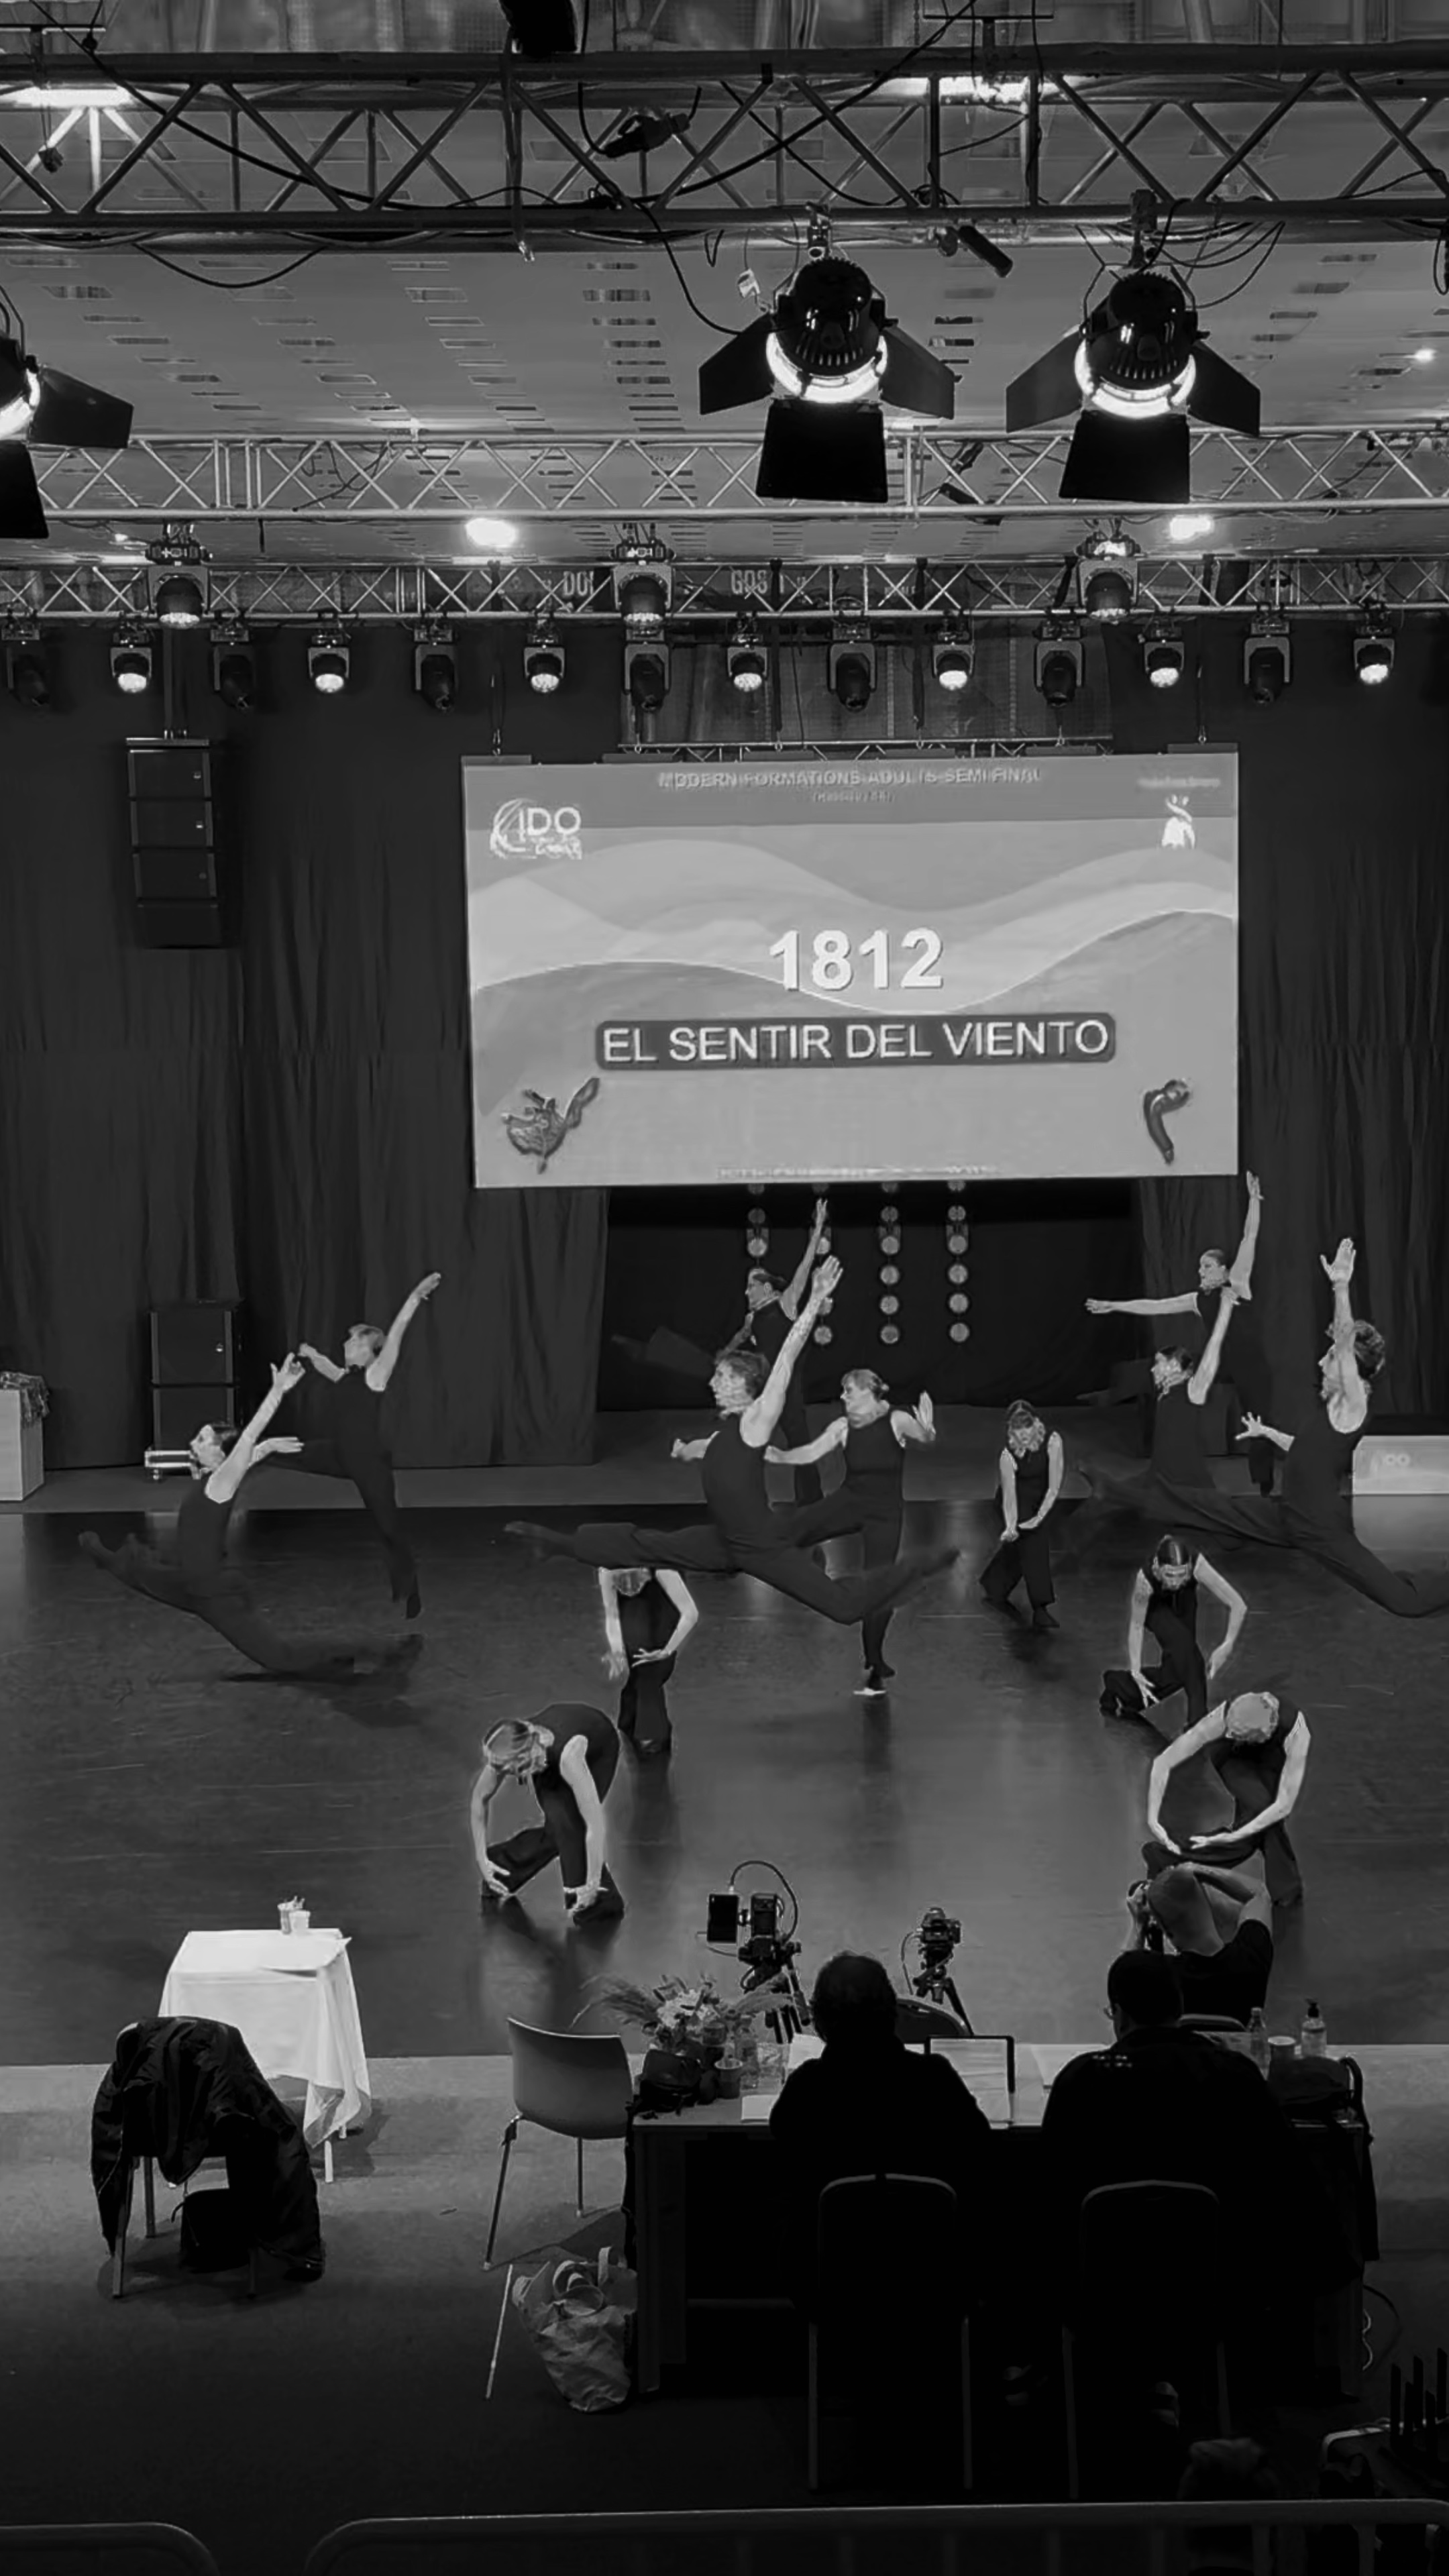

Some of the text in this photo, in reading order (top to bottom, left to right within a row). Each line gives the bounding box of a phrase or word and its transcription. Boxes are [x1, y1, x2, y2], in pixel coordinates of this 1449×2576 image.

[519, 807, 581, 843] IDO
[769, 928, 943, 990] 1812
[604, 1019, 1108, 1063] EL SENTIR DEL VIENTO
